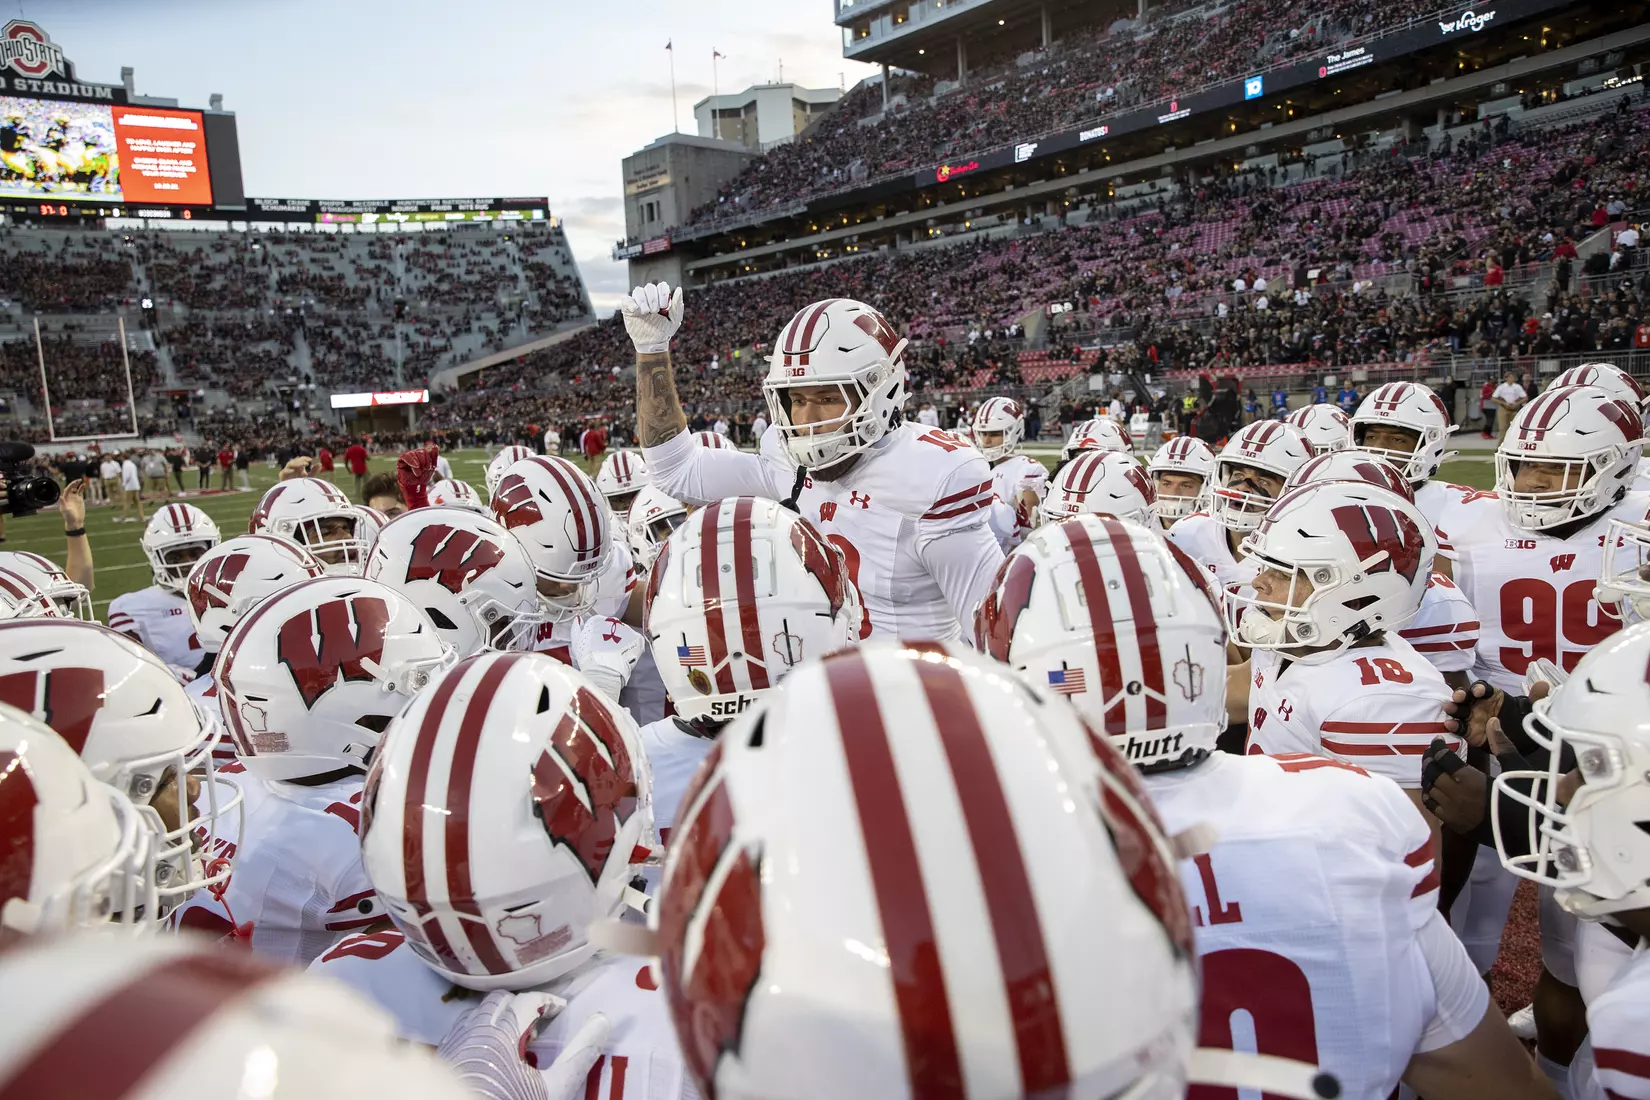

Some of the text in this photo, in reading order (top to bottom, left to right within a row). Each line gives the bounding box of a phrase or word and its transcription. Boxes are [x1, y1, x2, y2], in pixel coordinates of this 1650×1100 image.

[1456, 10, 1496, 31] Kroger
[23, 36, 66, 77] STATE
[1327, 55, 1341, 64] The
[1342, 47, 1365, 60] James
[14, 78, 113, 99] STADIUM
[1549, 553, 1577, 573] W
[1499, 578, 1623, 675] 99
[278, 597, 390, 711] W
[1352, 657, 1413, 685] 18
